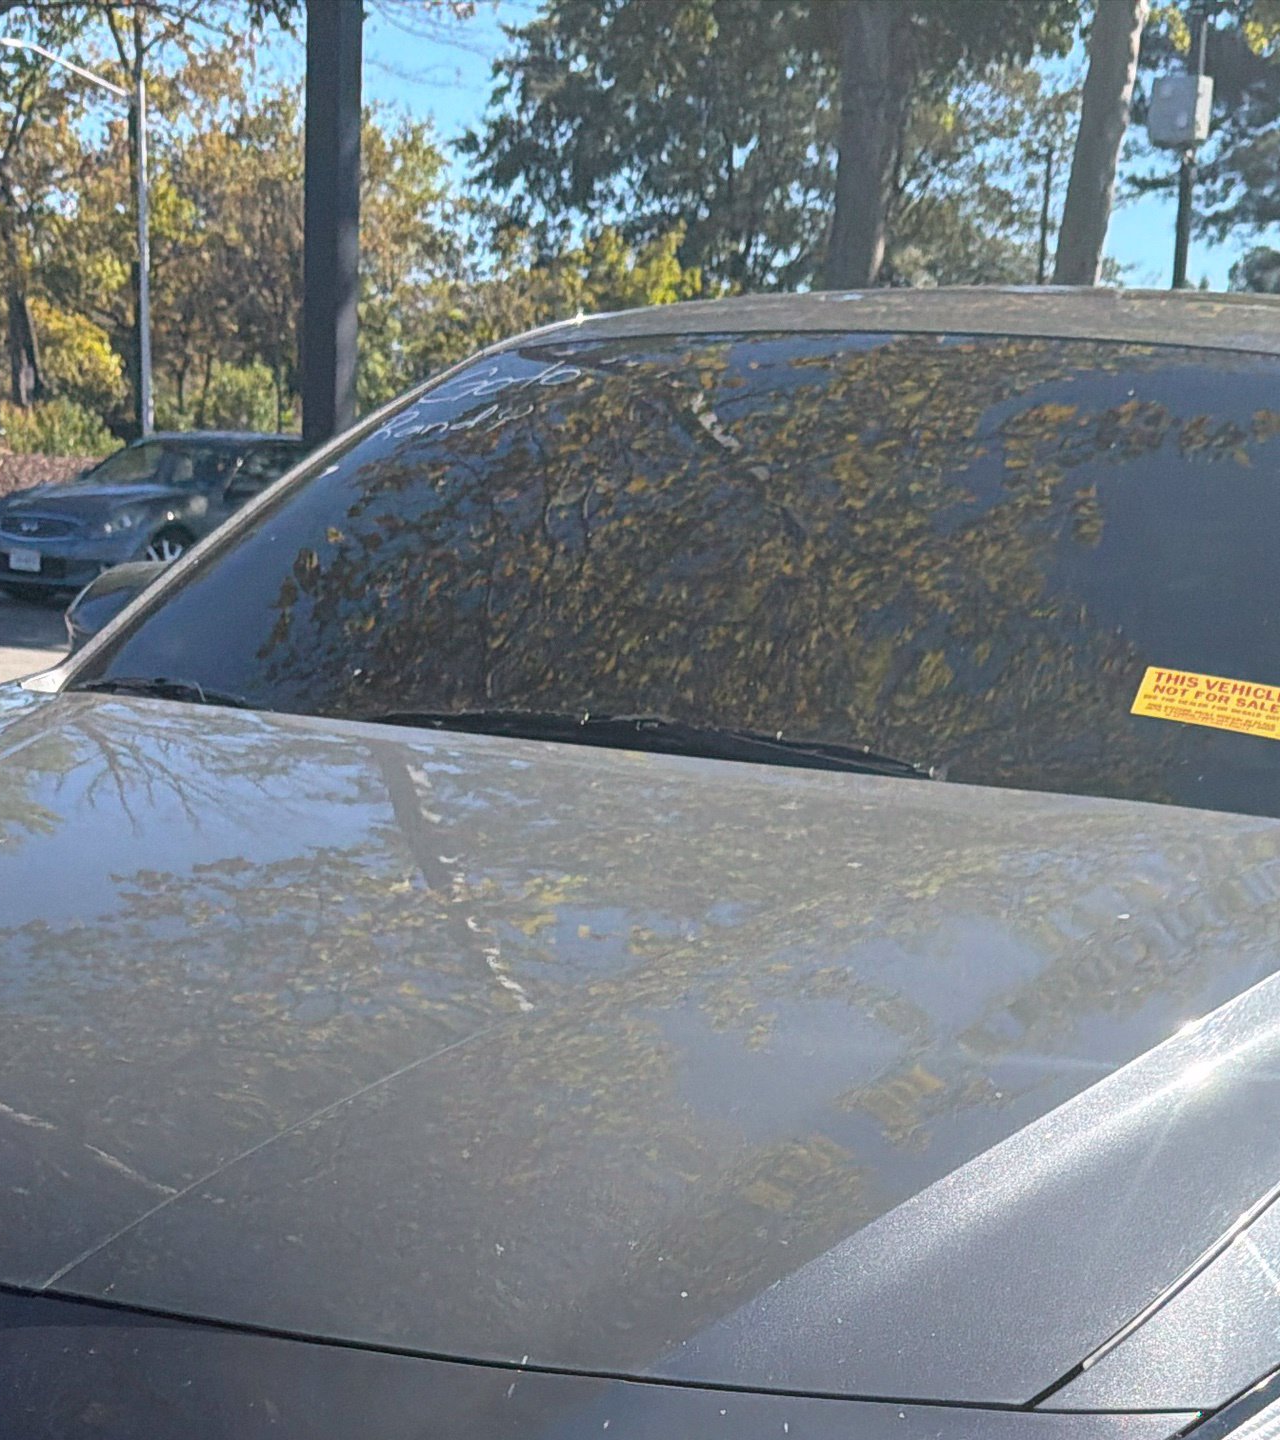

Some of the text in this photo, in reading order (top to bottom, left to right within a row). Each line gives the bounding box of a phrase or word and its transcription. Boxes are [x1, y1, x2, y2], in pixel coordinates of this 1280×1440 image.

[1154, 671, 1199, 688] THIS
[1153, 684, 1189, 697] NOT
[1194, 691, 1231, 705] FOR
